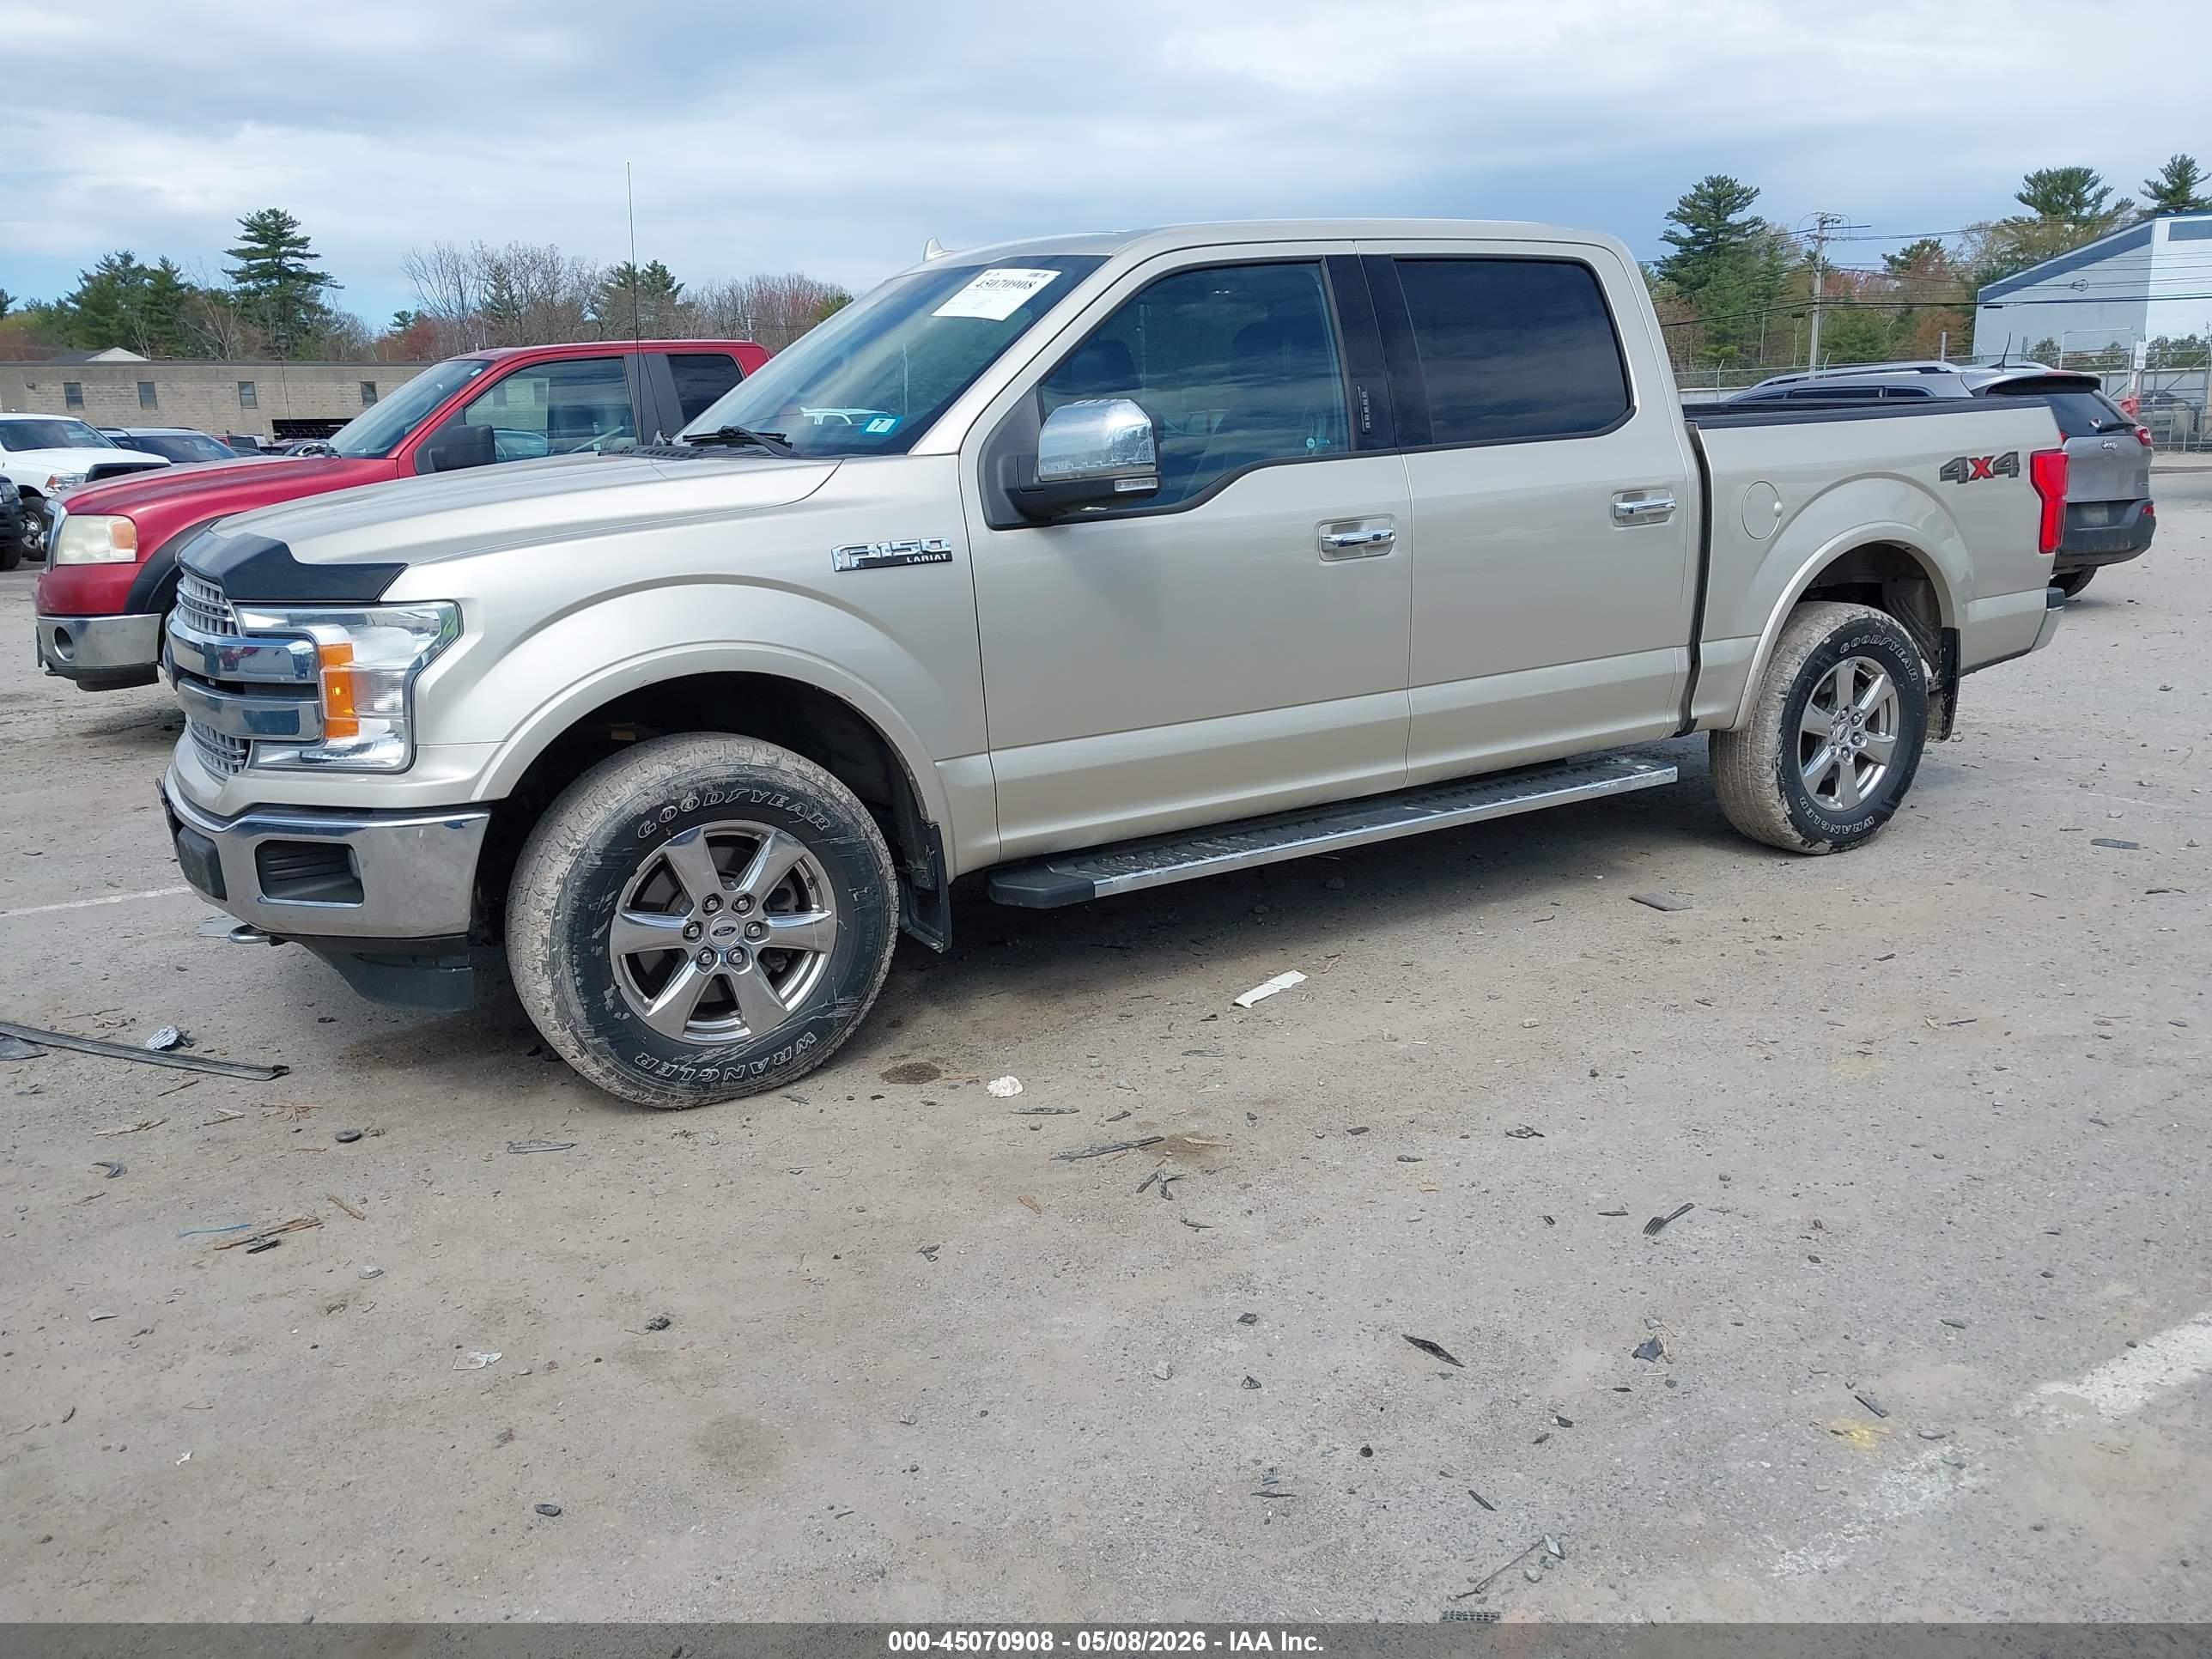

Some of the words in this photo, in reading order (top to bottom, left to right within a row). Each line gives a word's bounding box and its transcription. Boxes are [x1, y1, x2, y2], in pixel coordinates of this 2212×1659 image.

[975, 279, 1037, 290] 45070908
[873, 419, 886, 430] 7
[2101, 440, 2118, 451] Jeep
[906, 553, 948, 563] LARIAT
[1839, 635, 1918, 682] GOODYEAR
[637, 788, 831, 839] GOODYEAR
[1799, 796, 1875, 835] WRANGLER
[635, 1031, 817, 1084] WRANGLER
